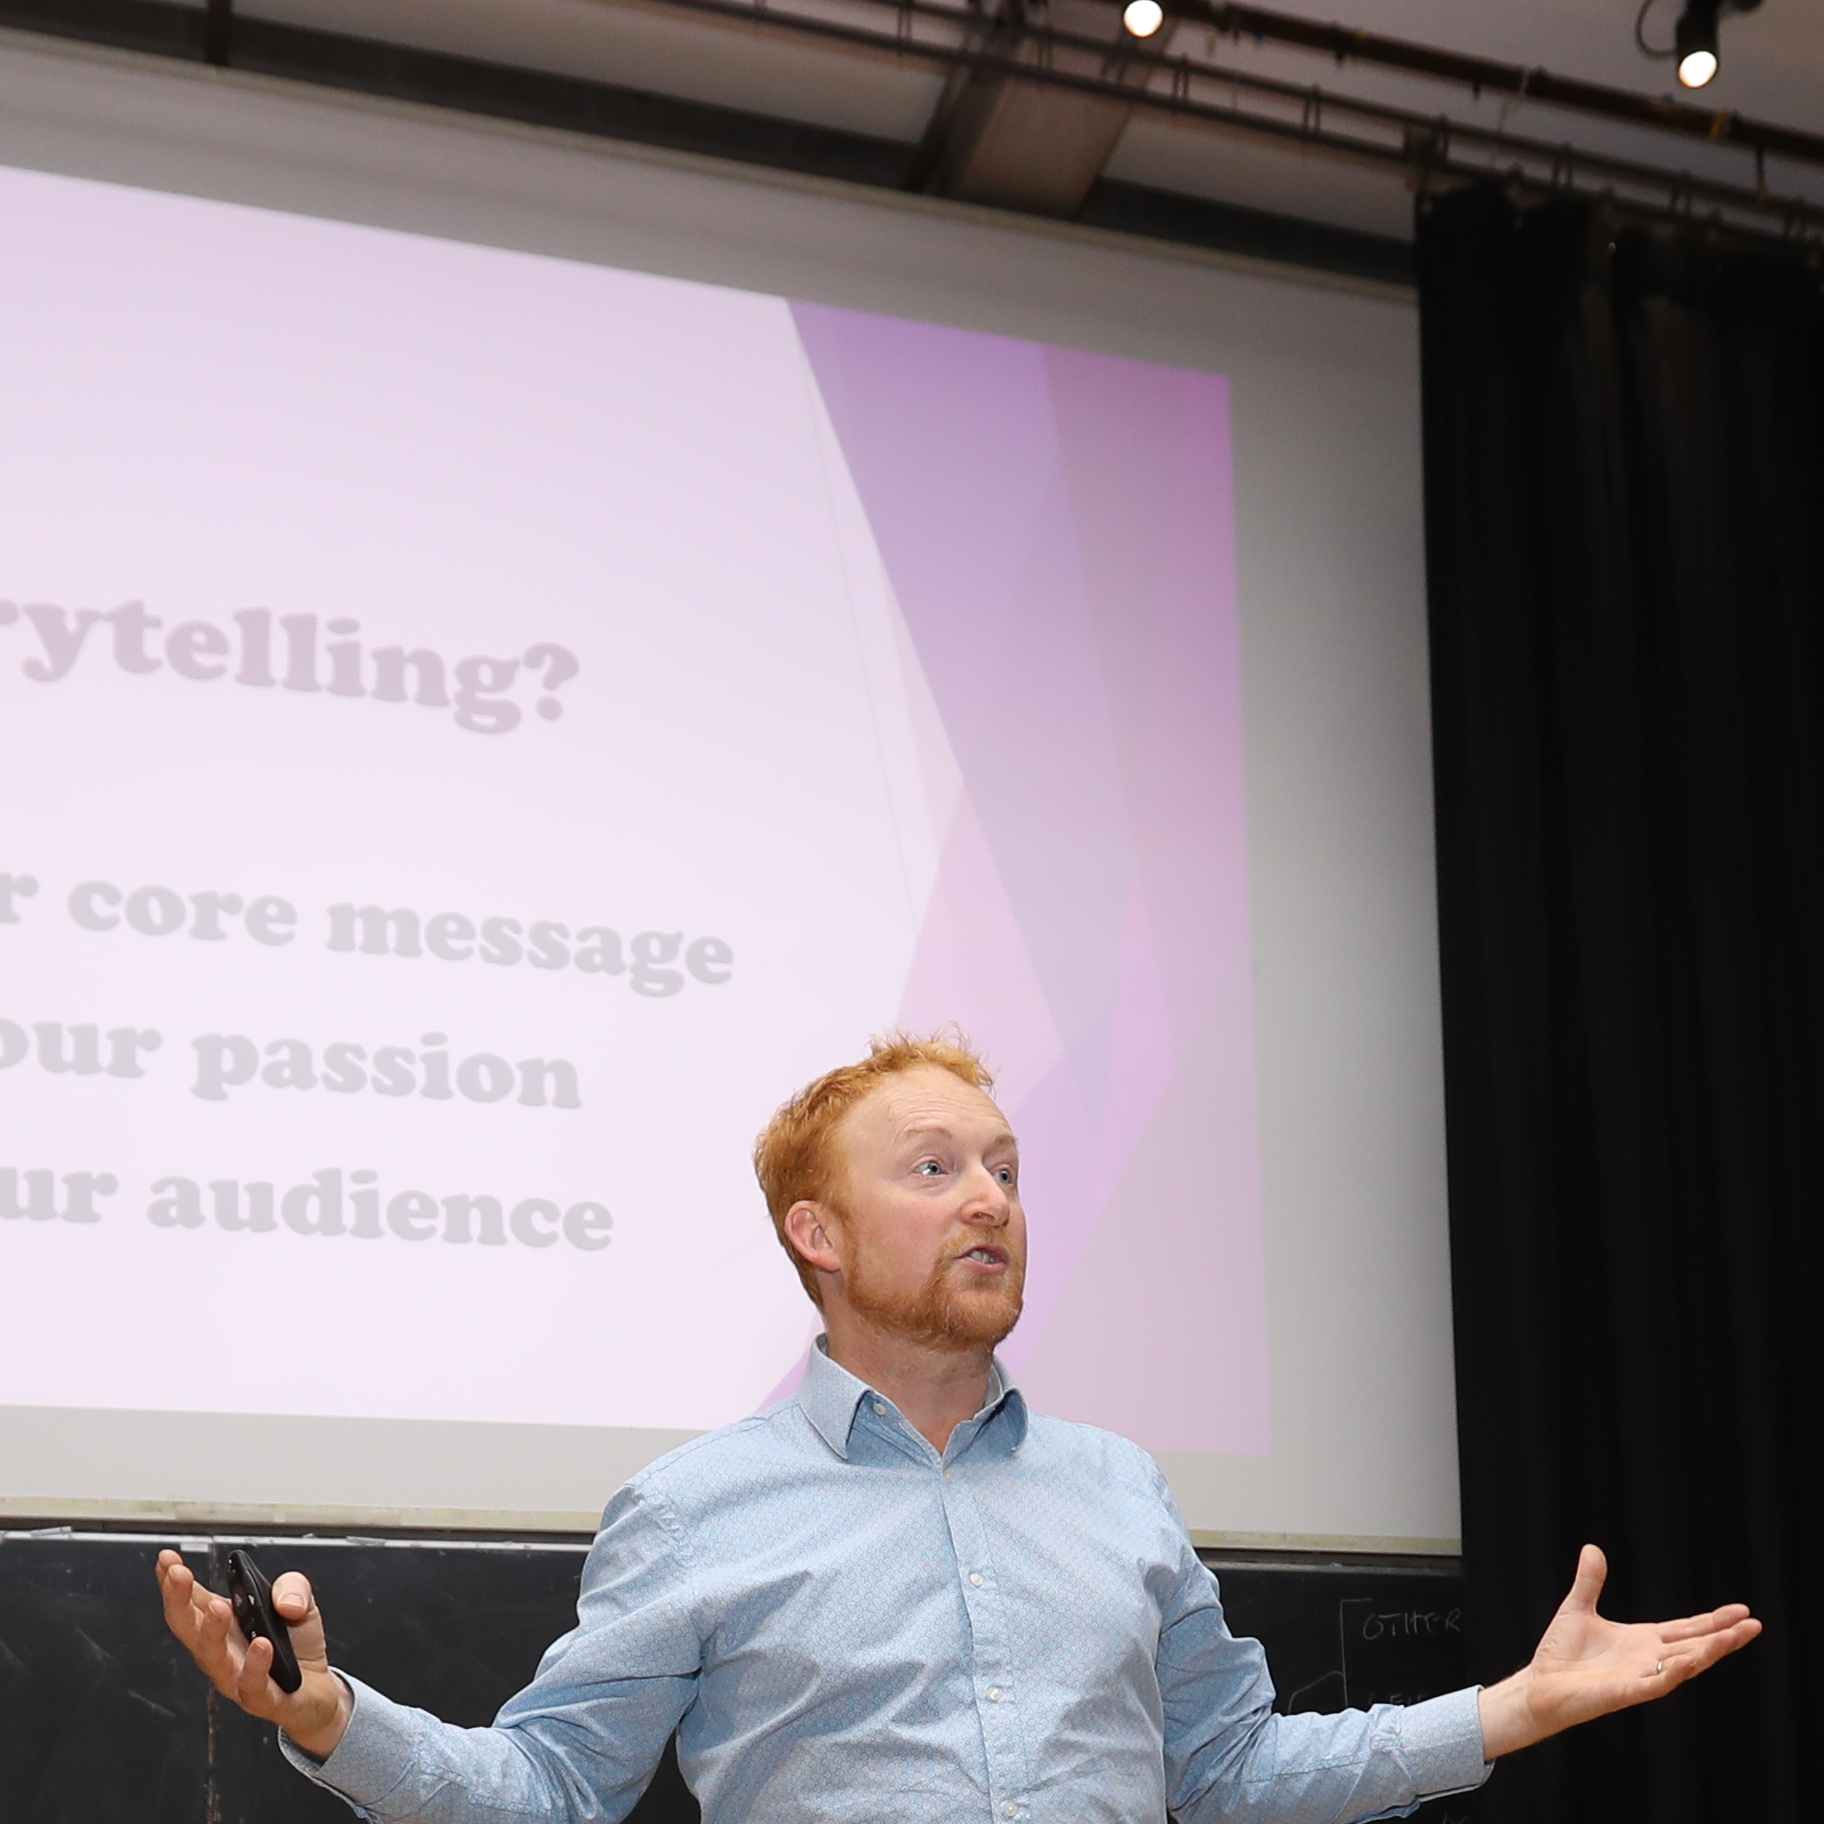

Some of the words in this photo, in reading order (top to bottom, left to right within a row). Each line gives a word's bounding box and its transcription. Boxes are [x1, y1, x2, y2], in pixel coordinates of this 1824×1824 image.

[68, 881, 296, 946] core
[327, 904, 733, 998] message
[191, 1033, 581, 1109] passion
[148, 1168, 613, 1251] audience
